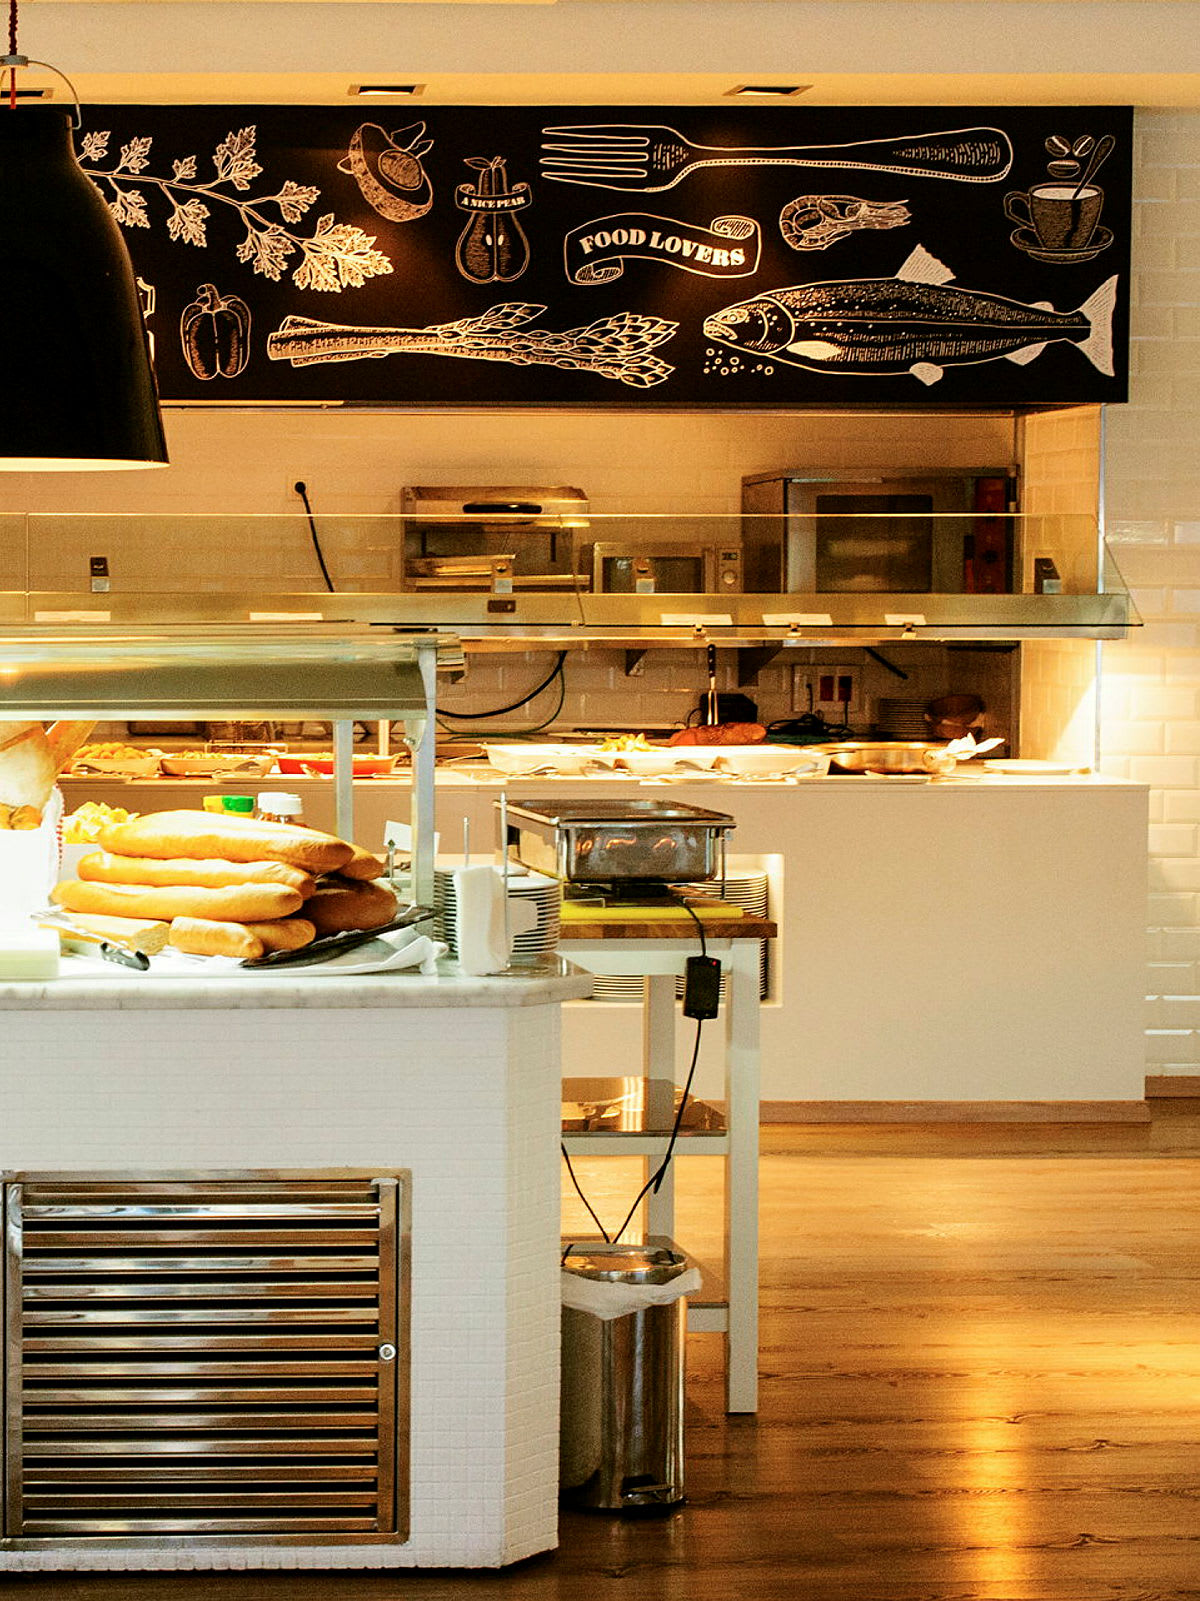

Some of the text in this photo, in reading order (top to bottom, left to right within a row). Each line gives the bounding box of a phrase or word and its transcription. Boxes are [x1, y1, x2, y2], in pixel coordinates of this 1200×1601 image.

[460, 196, 526, 208] A NICE PEAR
[579, 228, 746, 268] FOOD LOVERS
